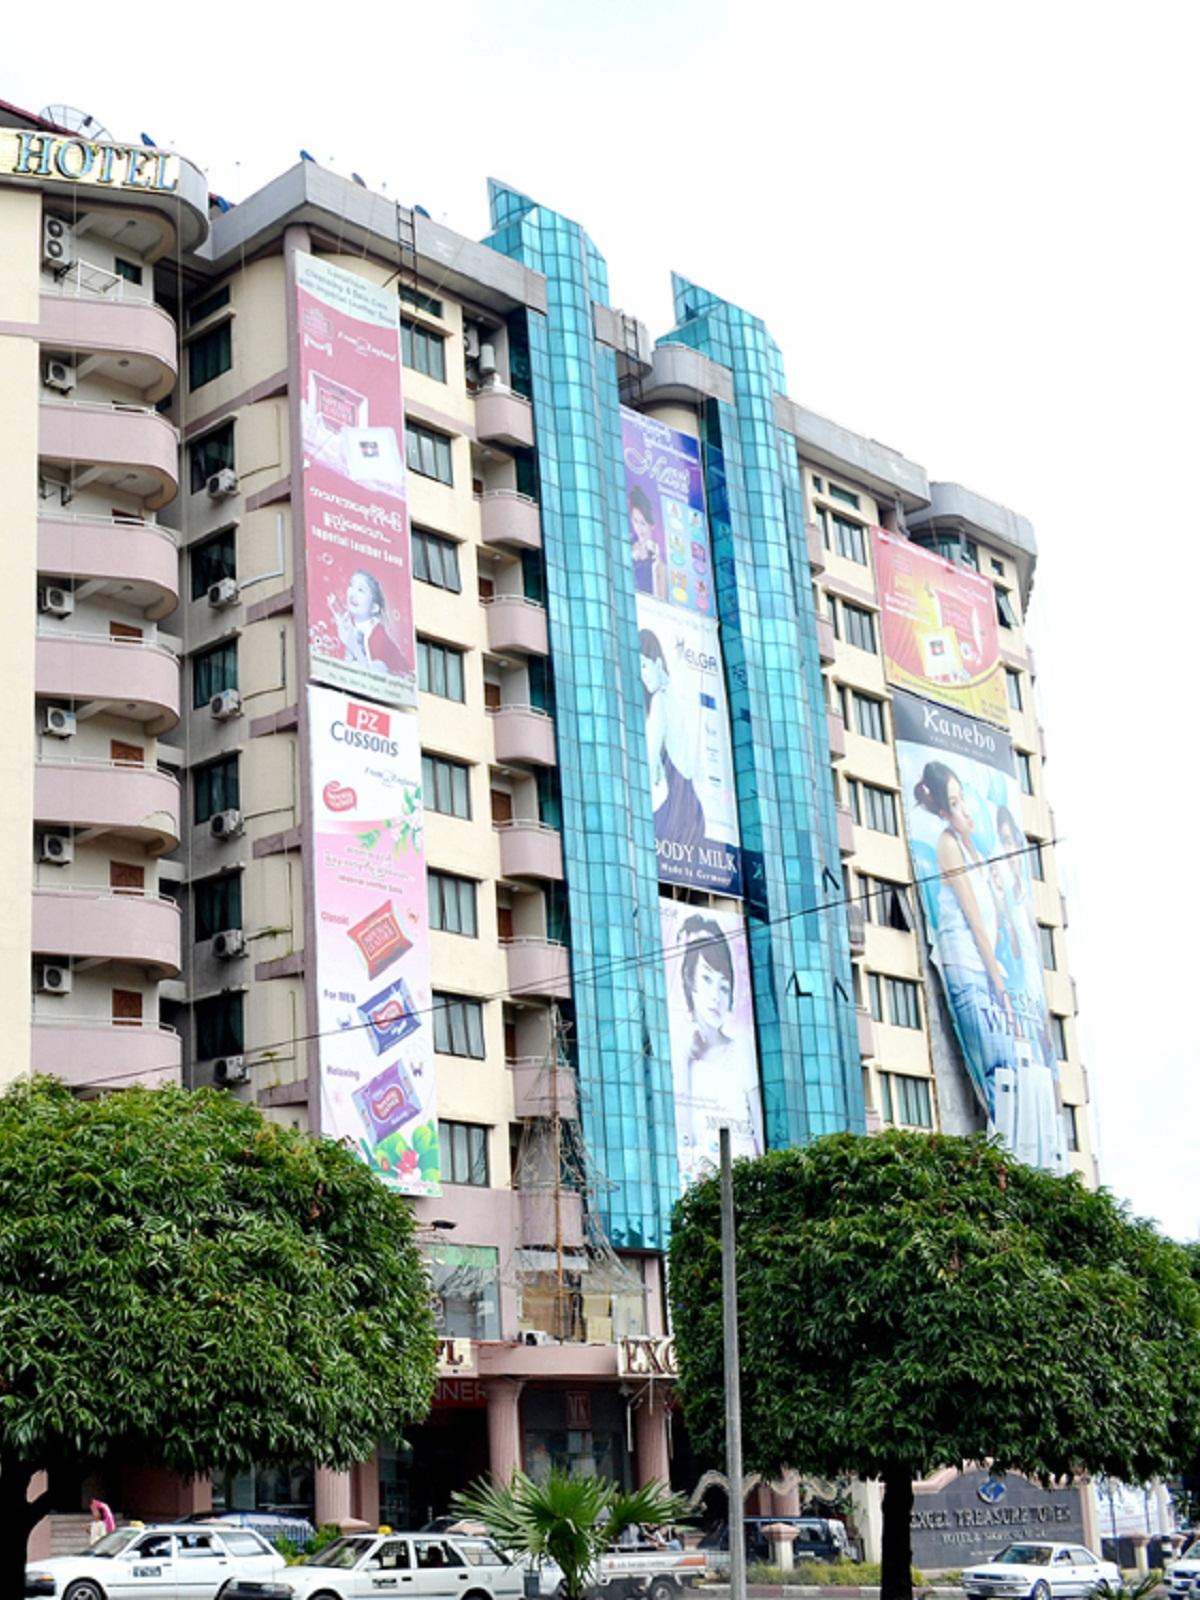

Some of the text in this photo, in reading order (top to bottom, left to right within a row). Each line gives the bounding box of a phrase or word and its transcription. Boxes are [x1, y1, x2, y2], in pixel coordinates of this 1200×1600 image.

[13, 132, 179, 192] HOTEL
[356, 709, 380, 732] PZ
[922, 706, 997, 752] Kanebo
[698, 846, 738, 874] MILK
[955, 1505, 1029, 1528] TREASURE
